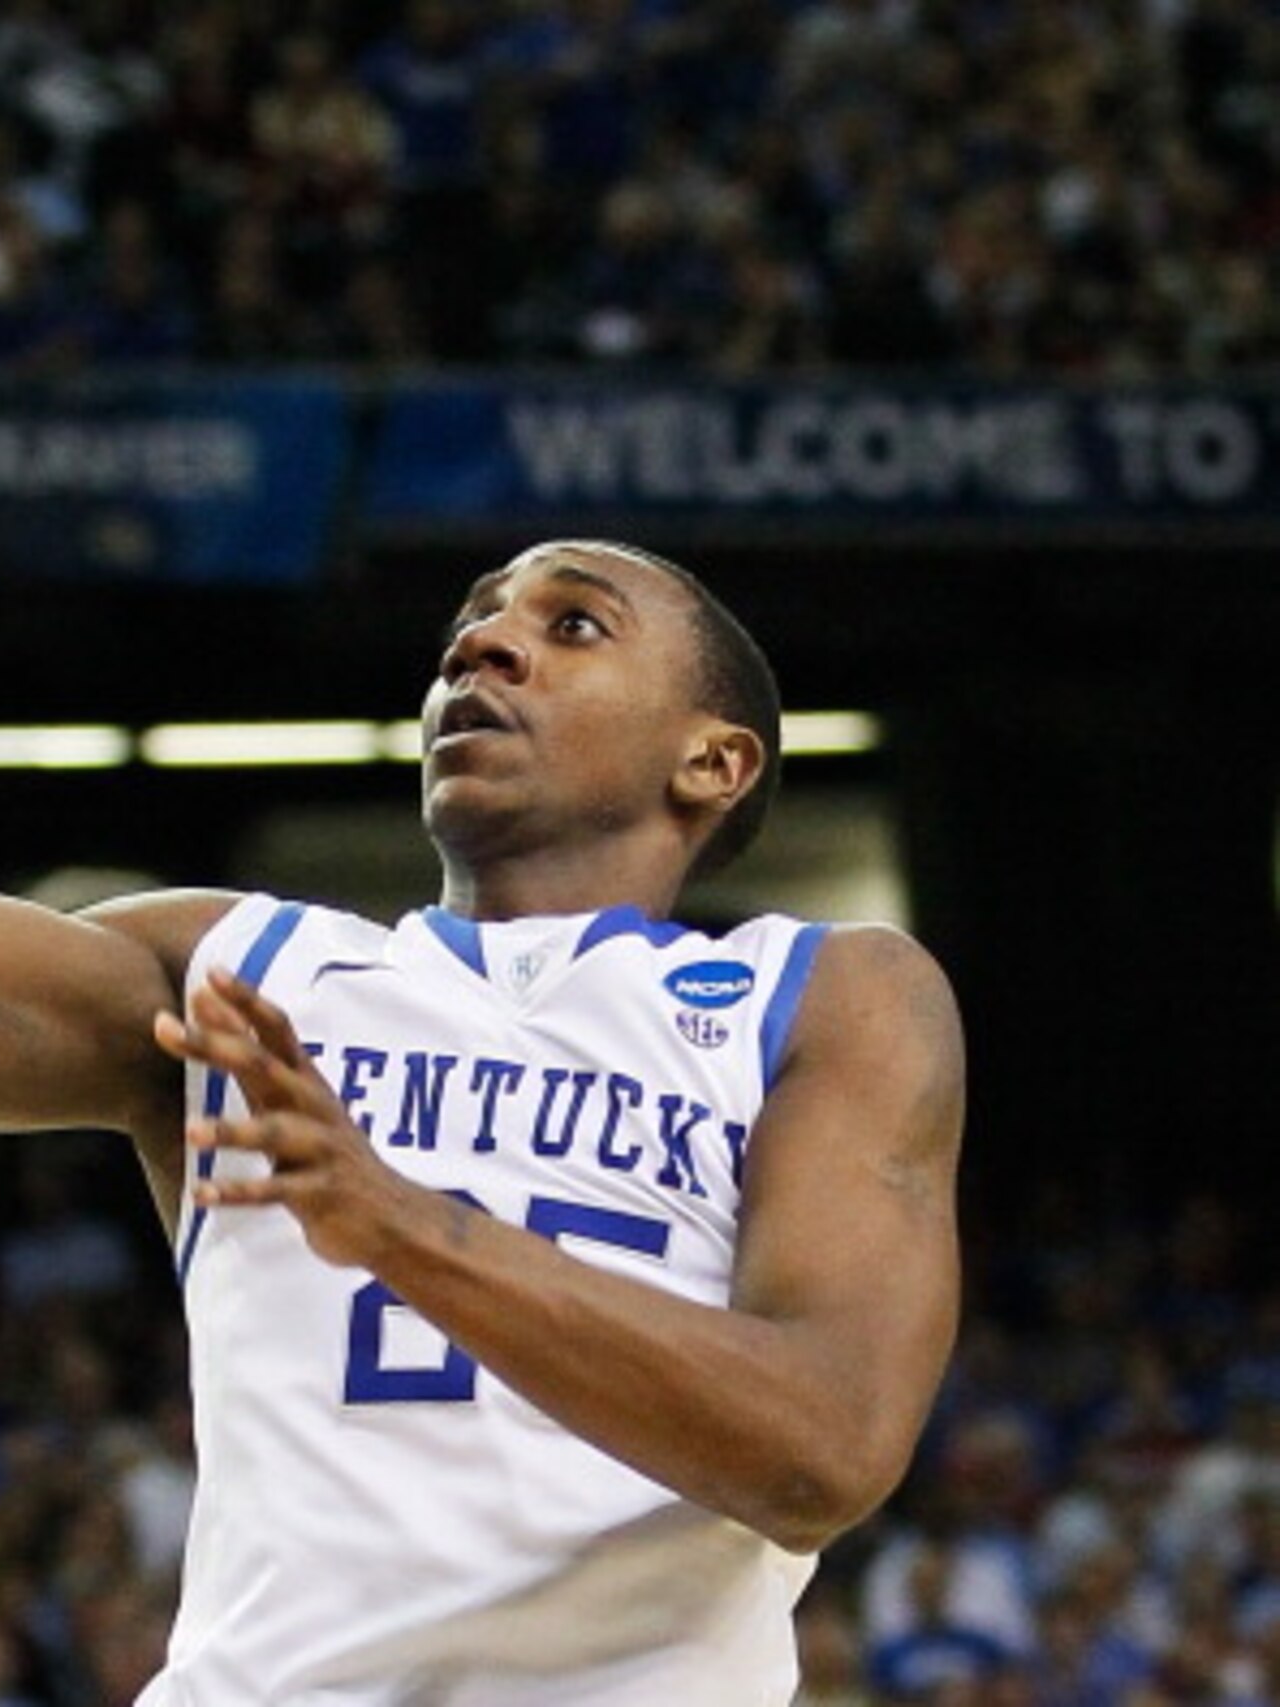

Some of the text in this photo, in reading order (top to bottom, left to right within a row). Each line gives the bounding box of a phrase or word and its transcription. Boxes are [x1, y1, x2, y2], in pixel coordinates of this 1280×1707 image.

[507, 396, 1262, 504] WELCOME TO
[300, 1042, 747, 1200] ENTUCK
